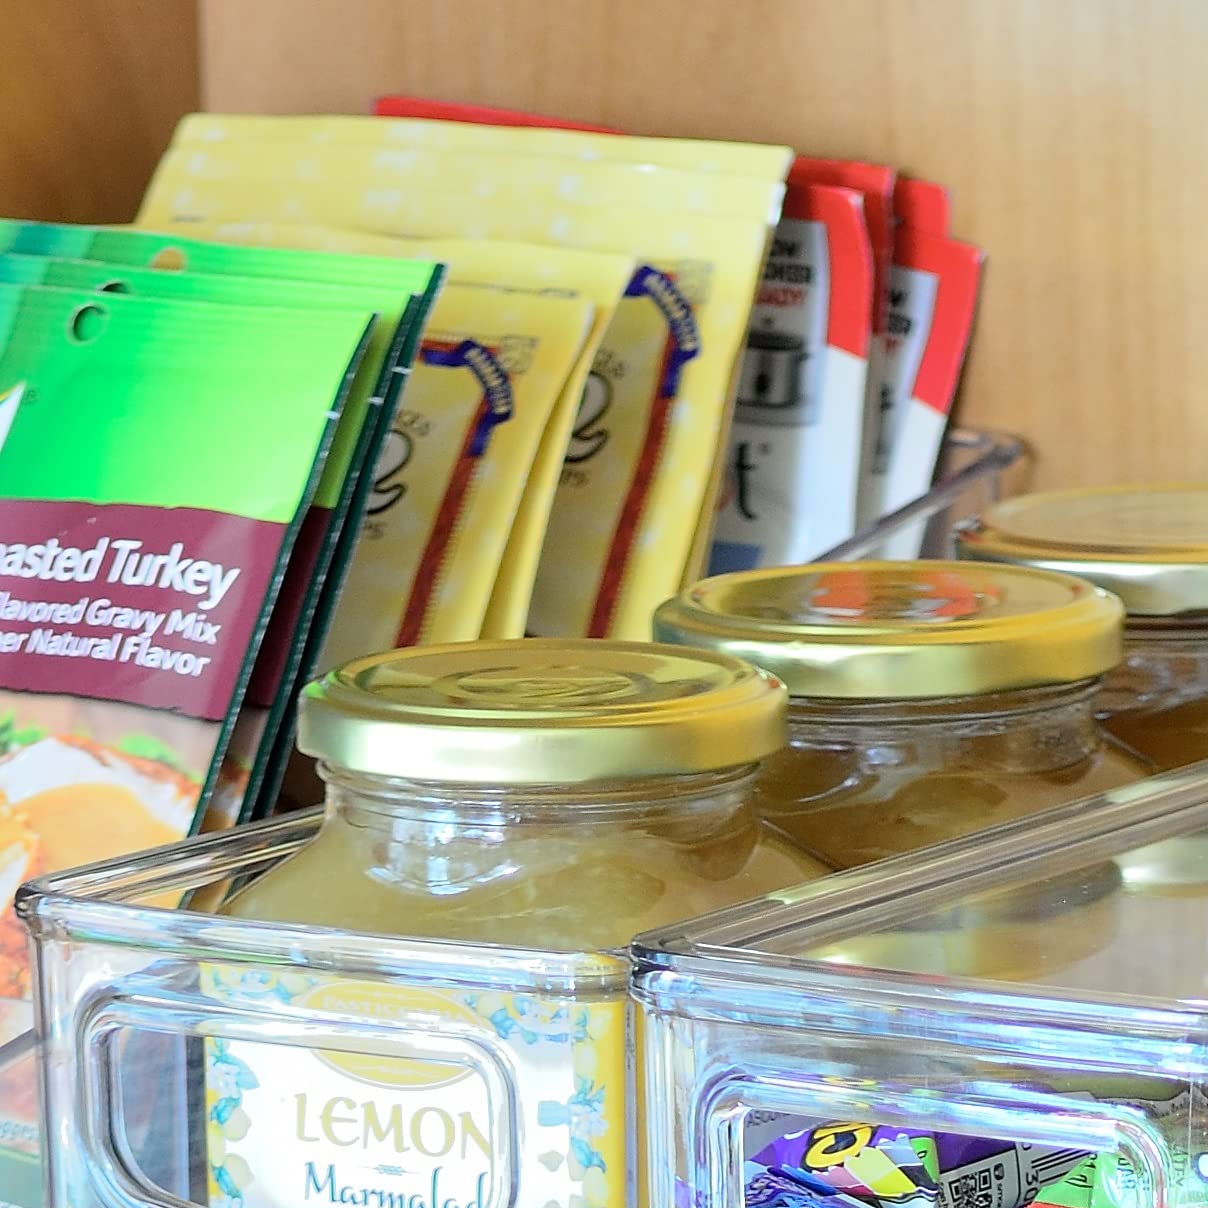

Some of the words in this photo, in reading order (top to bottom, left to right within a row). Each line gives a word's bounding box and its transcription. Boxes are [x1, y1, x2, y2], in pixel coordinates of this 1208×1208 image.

[107, 539, 241, 611] Turkey
[86, 598, 166, 638] Gravy
[163, 609, 222, 645] Mix
[25, 628, 123, 661] Natural
[119, 635, 212, 677] Flavor
[293, 1090, 494, 1162] LEMON
